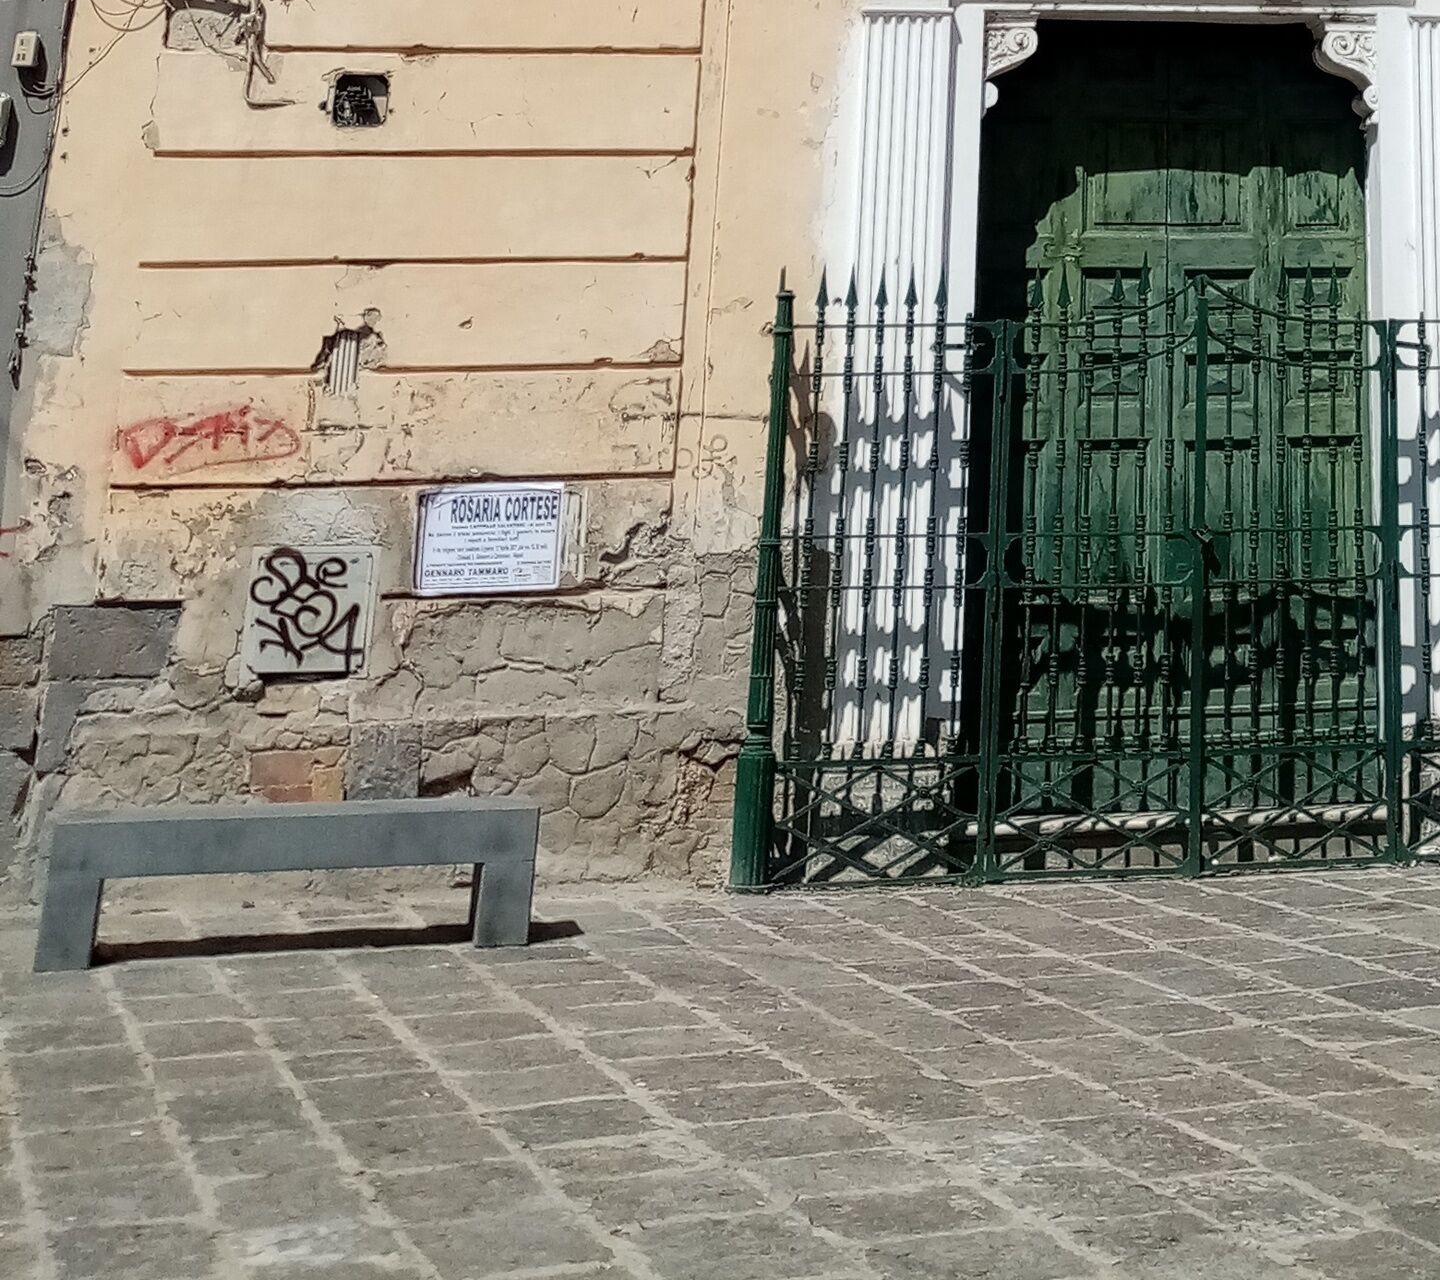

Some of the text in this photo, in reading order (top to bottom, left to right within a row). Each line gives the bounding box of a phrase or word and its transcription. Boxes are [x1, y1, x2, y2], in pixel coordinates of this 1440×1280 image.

[451, 496, 558, 523] ROSARIA CORTESE
[424, 568, 465, 577] GENNARO
[468, 567, 509, 576] TAMMARO
